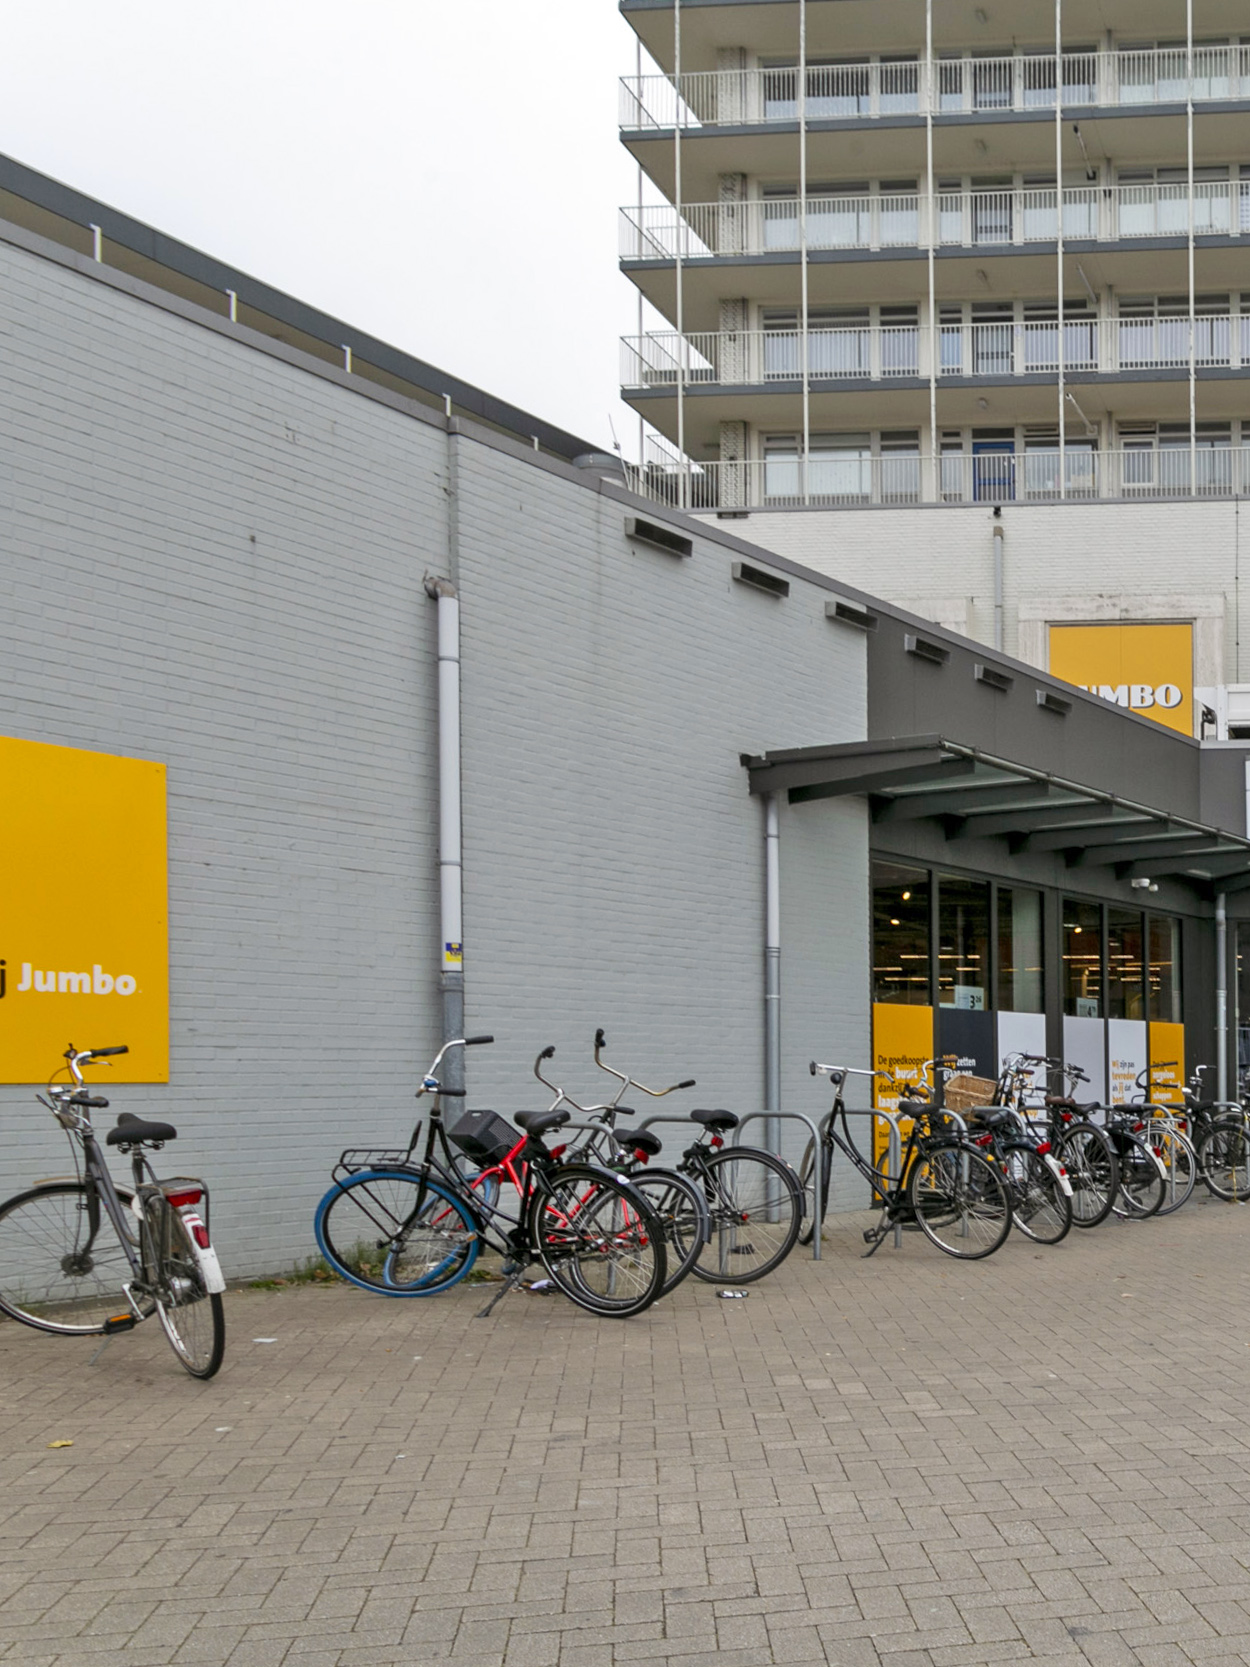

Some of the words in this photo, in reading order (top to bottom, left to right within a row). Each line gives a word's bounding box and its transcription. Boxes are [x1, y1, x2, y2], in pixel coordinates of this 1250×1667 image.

[1078, 684, 1183, 709] MBO
[17, 962, 137, 996] Jumbo
[878, 1055, 888, 1065] De
[895, 1067, 918, 1079] buurt
